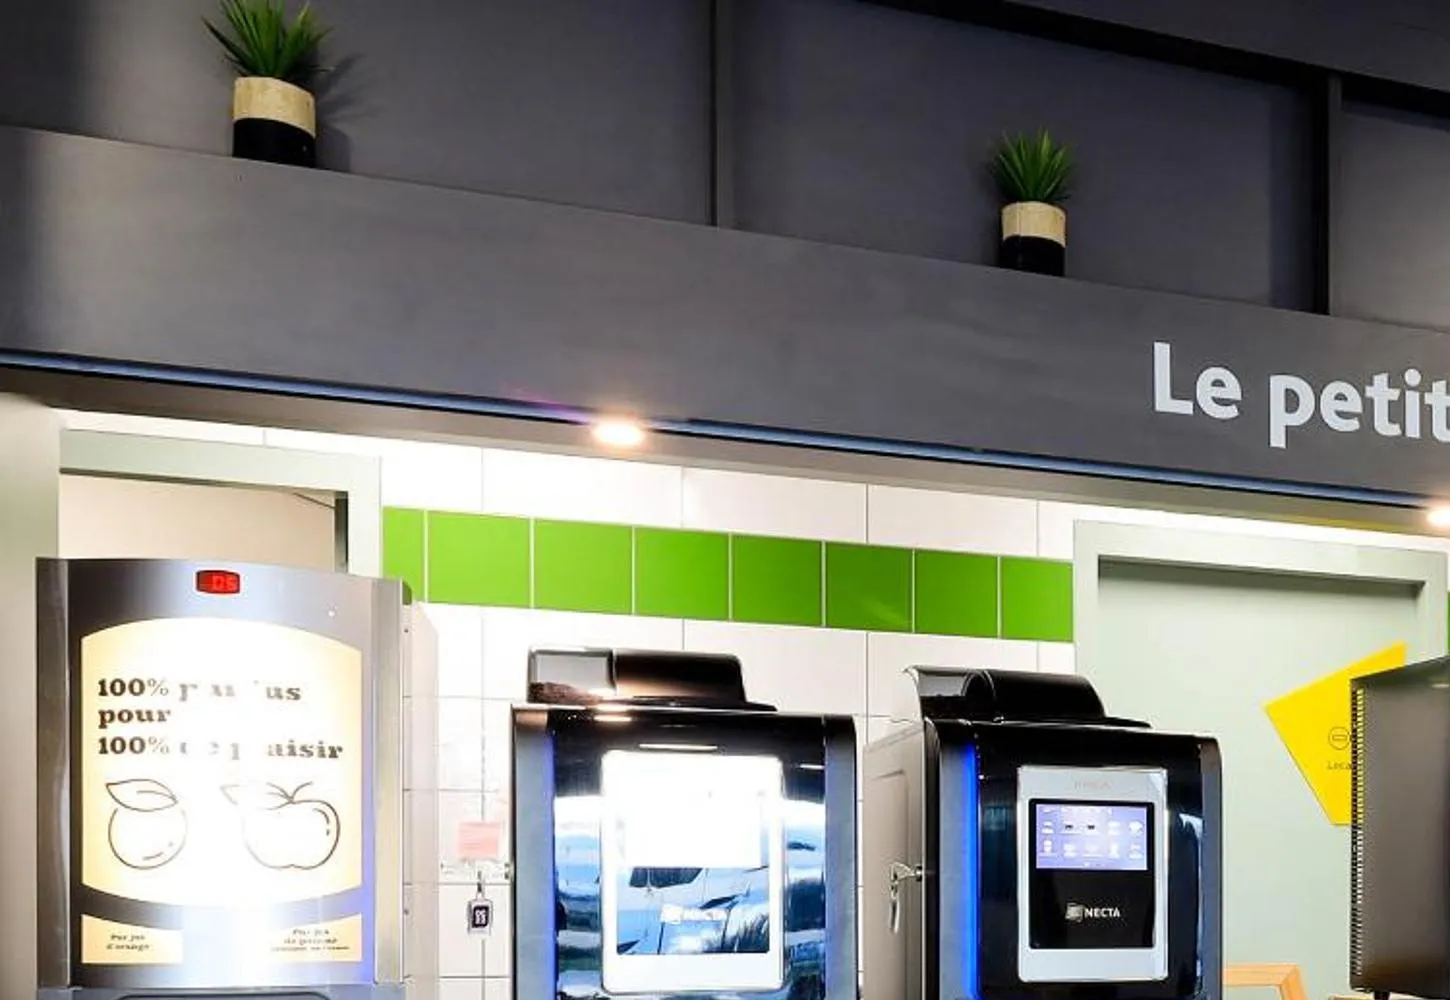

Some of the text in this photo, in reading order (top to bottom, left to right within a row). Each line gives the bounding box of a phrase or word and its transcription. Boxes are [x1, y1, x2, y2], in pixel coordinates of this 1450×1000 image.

[1153, 341, 1243, 420] Le
[98, 678, 169, 697] 100%
[98, 707, 171, 729] pour
[98, 736, 169, 755] 100%
[1084, 907, 1121, 918] NECTA
